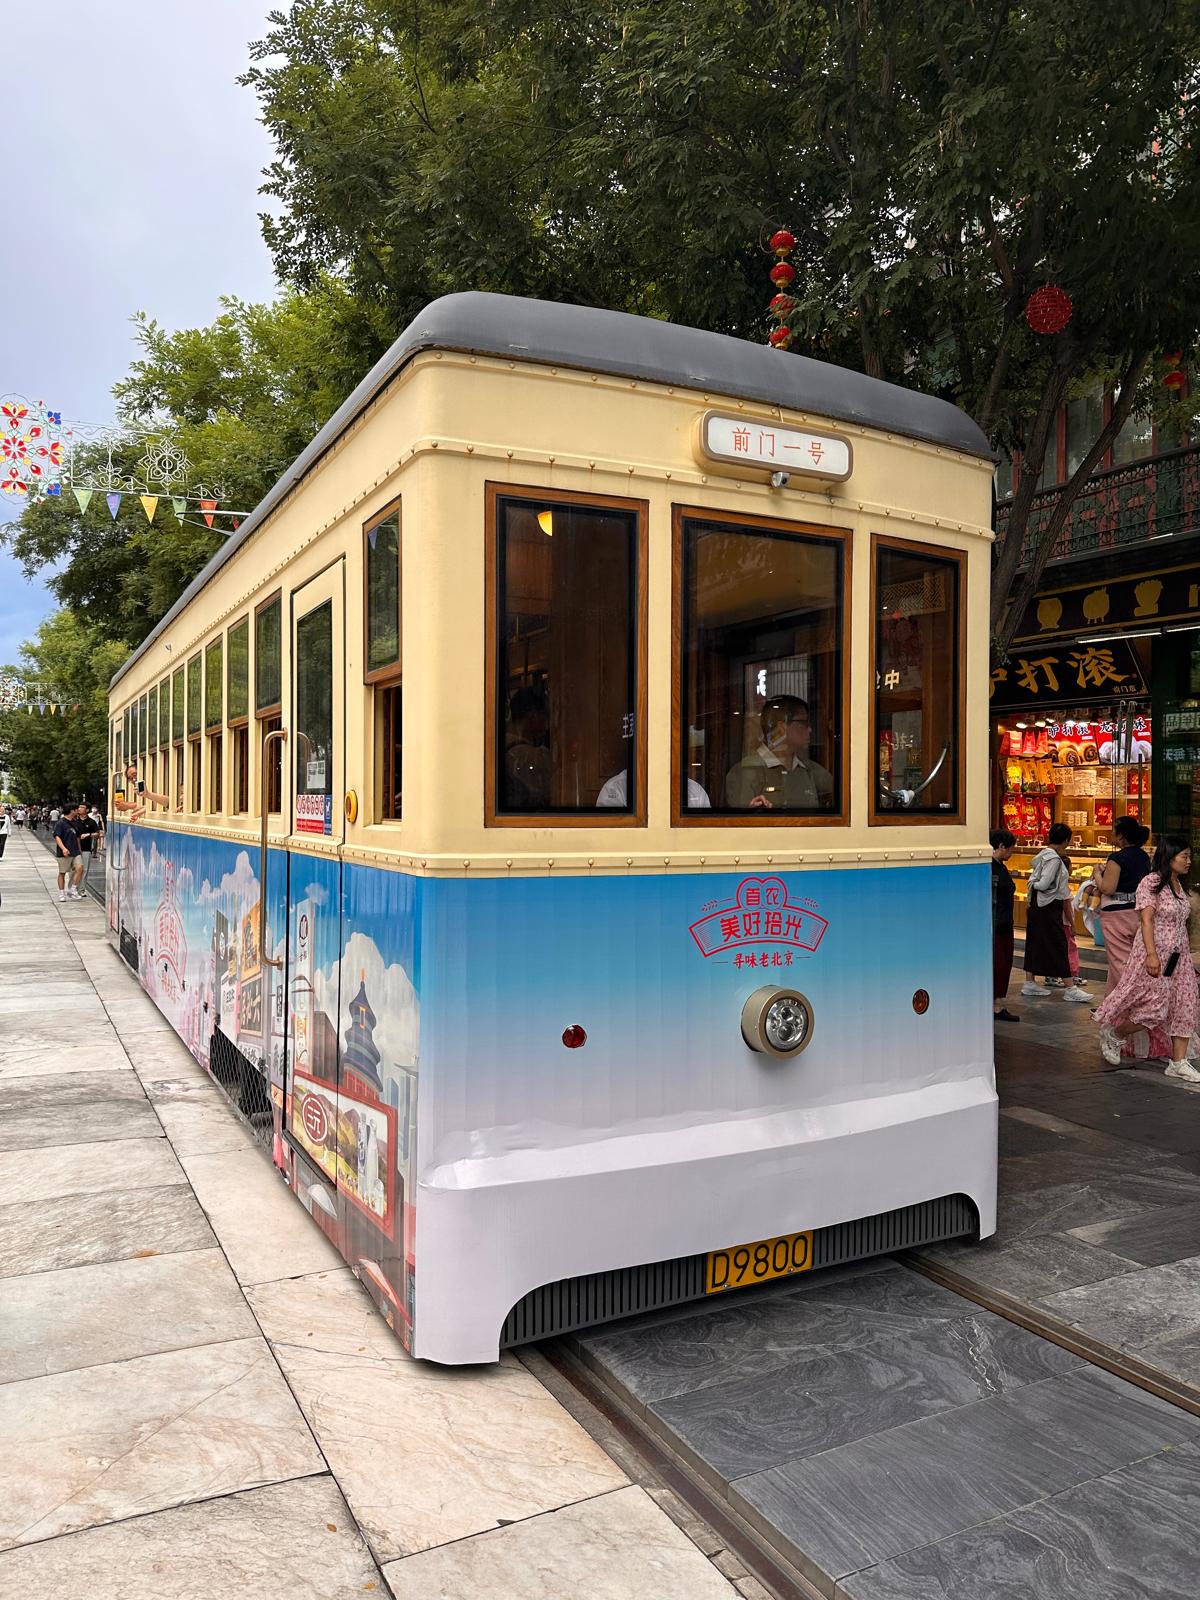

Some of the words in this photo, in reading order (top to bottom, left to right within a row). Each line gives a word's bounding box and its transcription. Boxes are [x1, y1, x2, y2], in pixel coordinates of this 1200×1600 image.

[732, 427, 825, 465] 前门一号
[745, 888, 780, 906] 首农
[720, 911, 803, 943] 美好拾光
[733, 951, 794, 969] 寻味老北京
[712, 1235, 808, 1288] D9800
